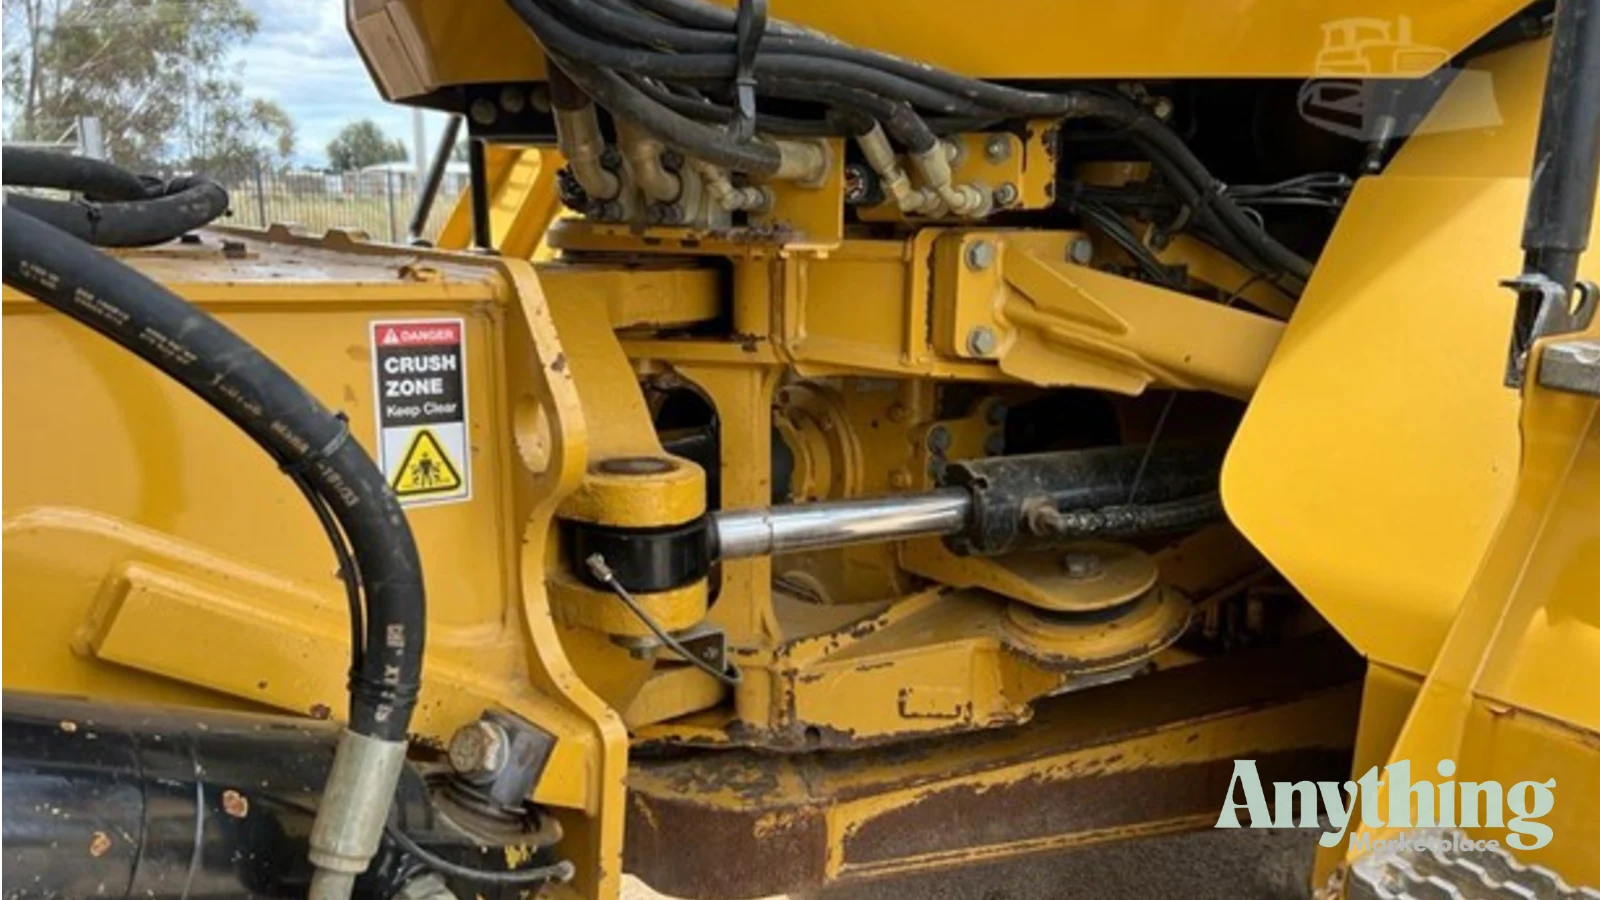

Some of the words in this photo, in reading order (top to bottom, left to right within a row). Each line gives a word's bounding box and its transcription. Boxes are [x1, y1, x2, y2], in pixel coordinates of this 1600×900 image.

[400, 330, 454, 342] DANGER
[384, 354, 456, 374] CRUSH
[385, 378, 443, 398] ZONE
[386, 404, 421, 419] Keep
[423, 401, 457, 415] Clear
